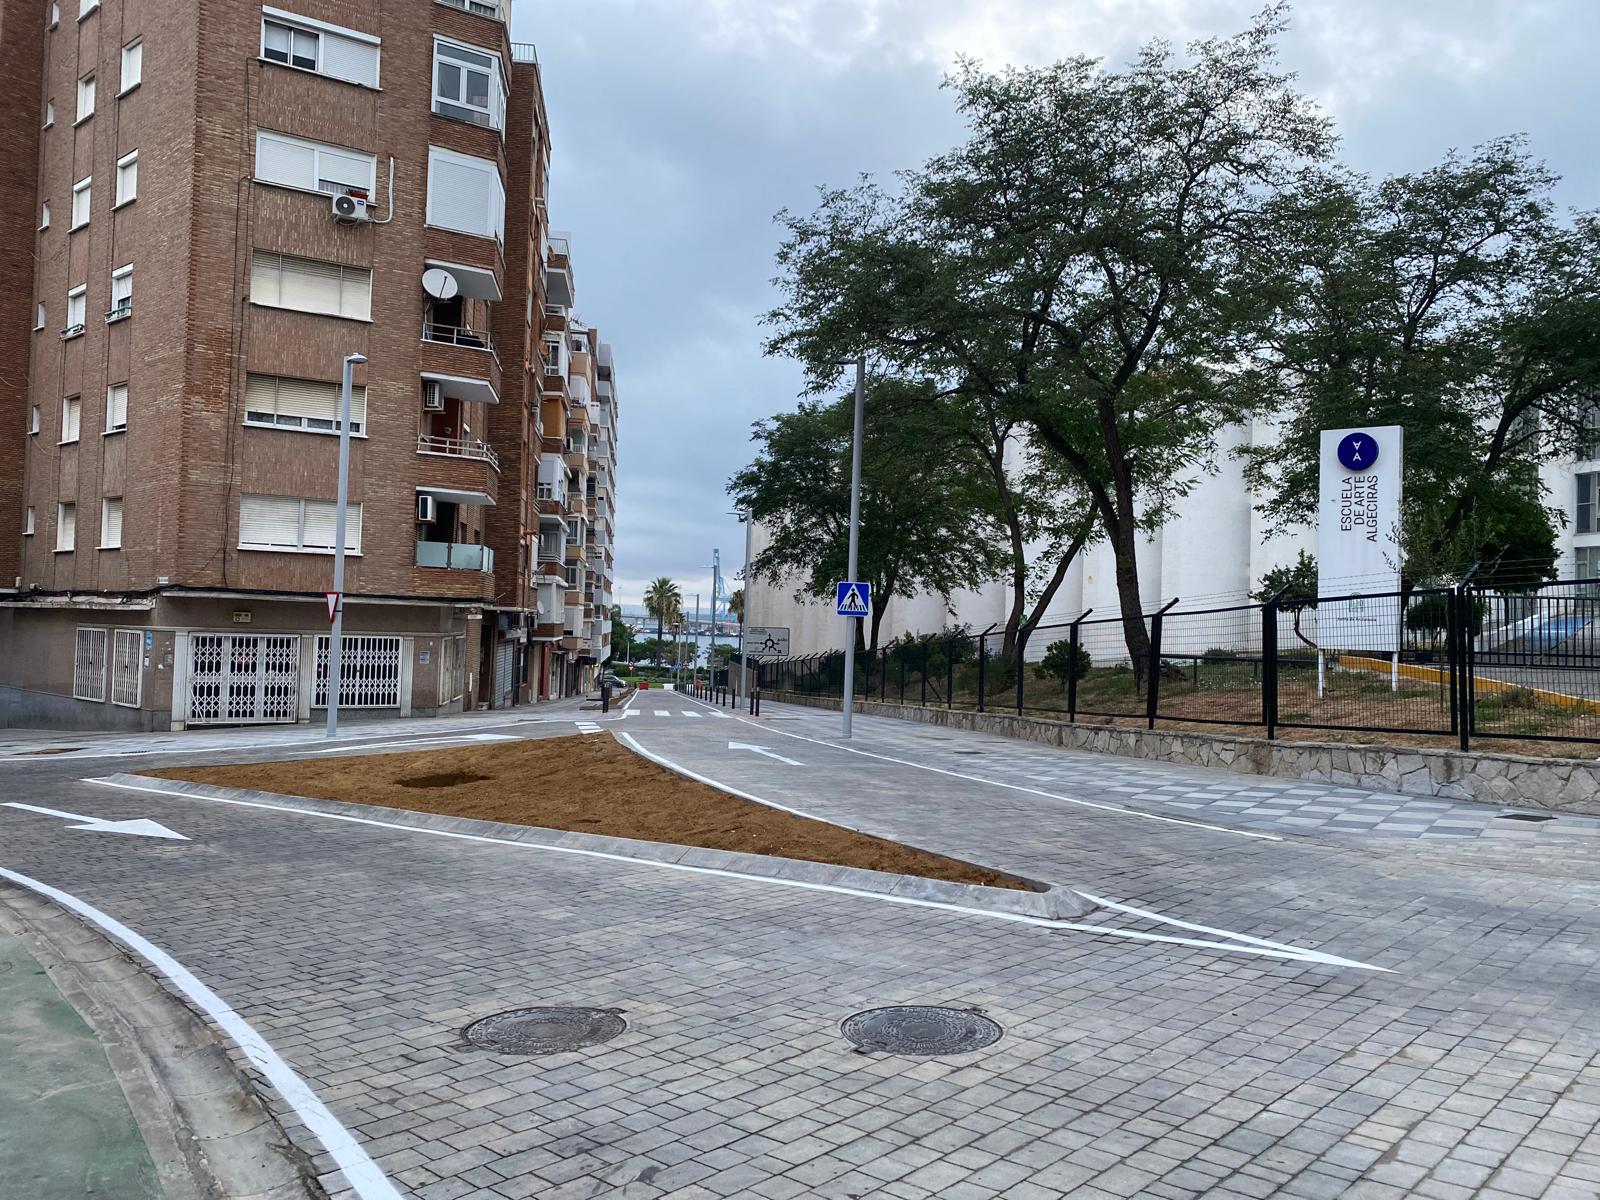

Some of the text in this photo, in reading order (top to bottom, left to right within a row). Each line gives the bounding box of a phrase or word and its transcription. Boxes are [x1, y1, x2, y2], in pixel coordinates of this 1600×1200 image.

[1341, 476, 1352, 532] ESCUELA
[1354, 476, 1366, 525] DE ARTE
[1366, 475, 1378, 543] ALGECIRAS
